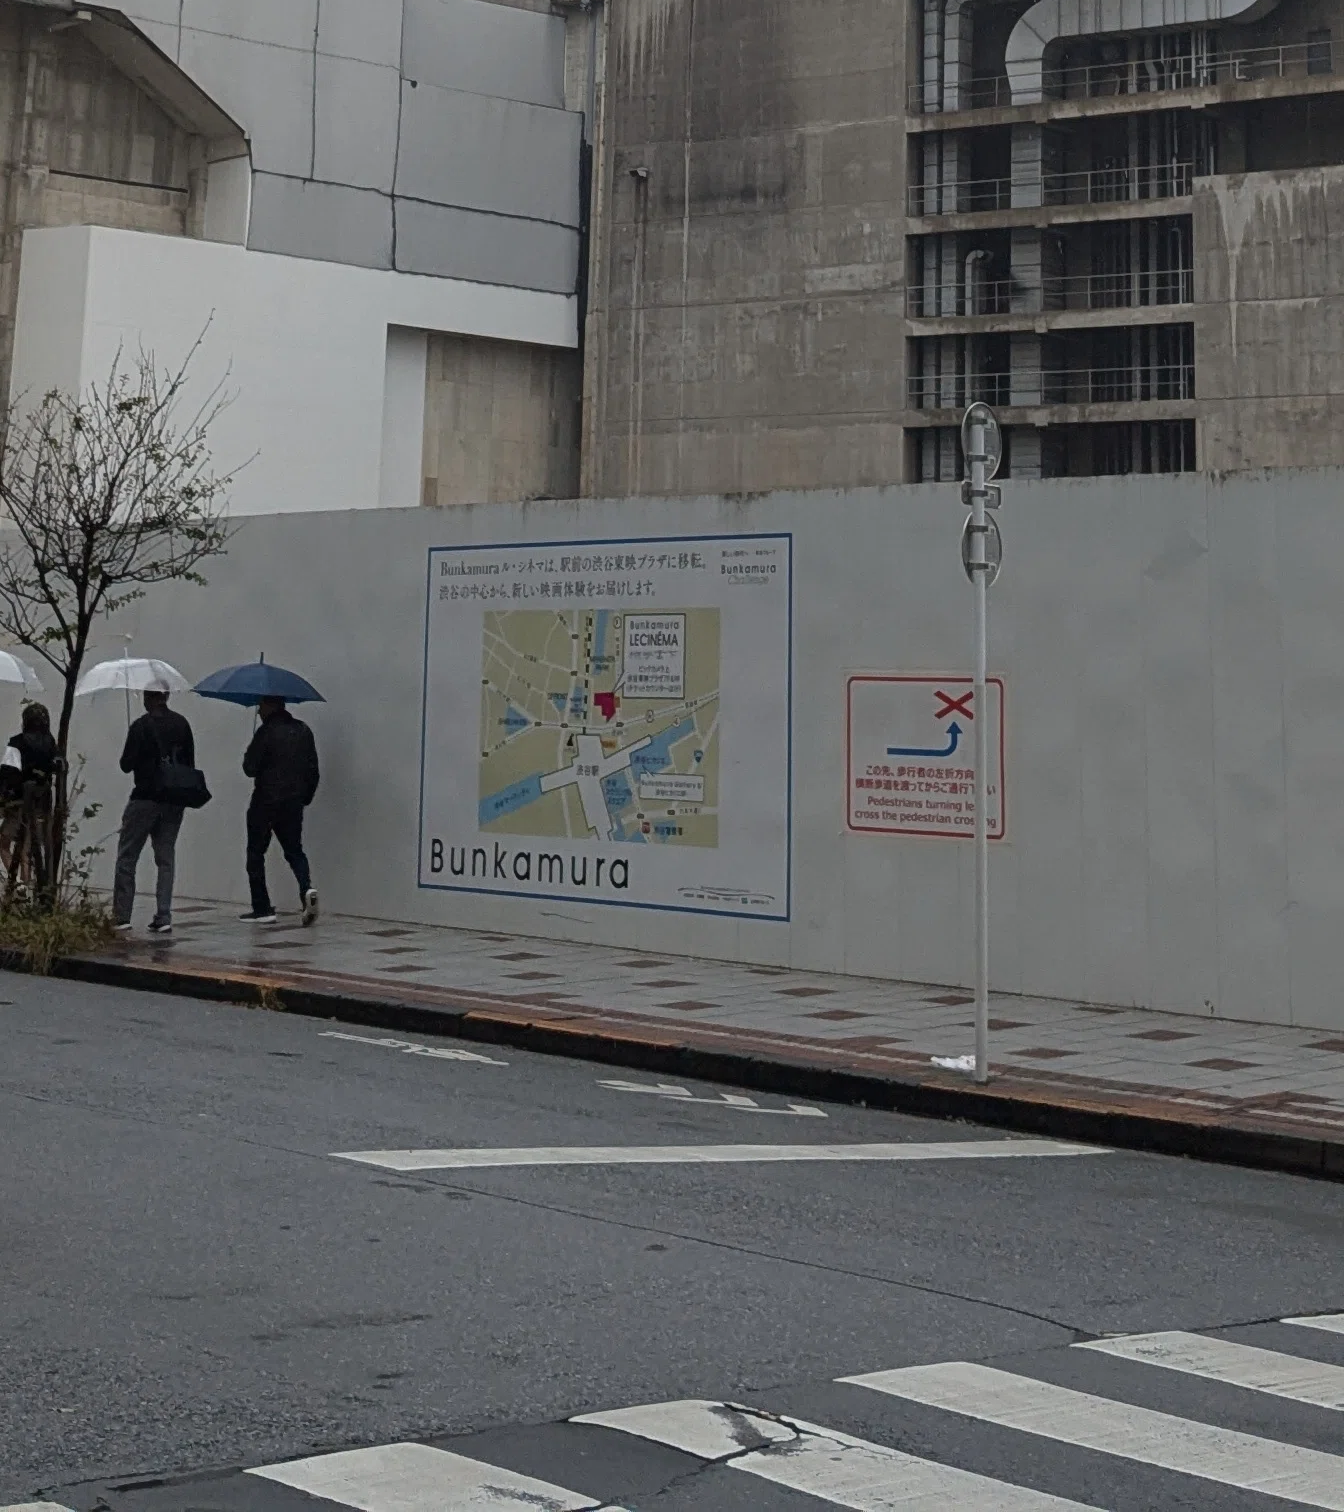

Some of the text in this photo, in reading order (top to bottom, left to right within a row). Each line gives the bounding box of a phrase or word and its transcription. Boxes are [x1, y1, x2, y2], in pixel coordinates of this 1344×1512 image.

[721, 564, 776, 575] Bunkamura
[629, 620, 679, 630] Bunkamura
[866, 765, 975, 781] この先、歩行者の左折方向
[855, 777, 996, 796] 横断歩道を渡ってからご通行下い
[867, 796, 923, 809] Pedestrians
[926, 799, 962, 813] turning
[855, 810, 997, 829] cross the pedestrian crosng
[430, 838, 630, 889] Bunkamura
